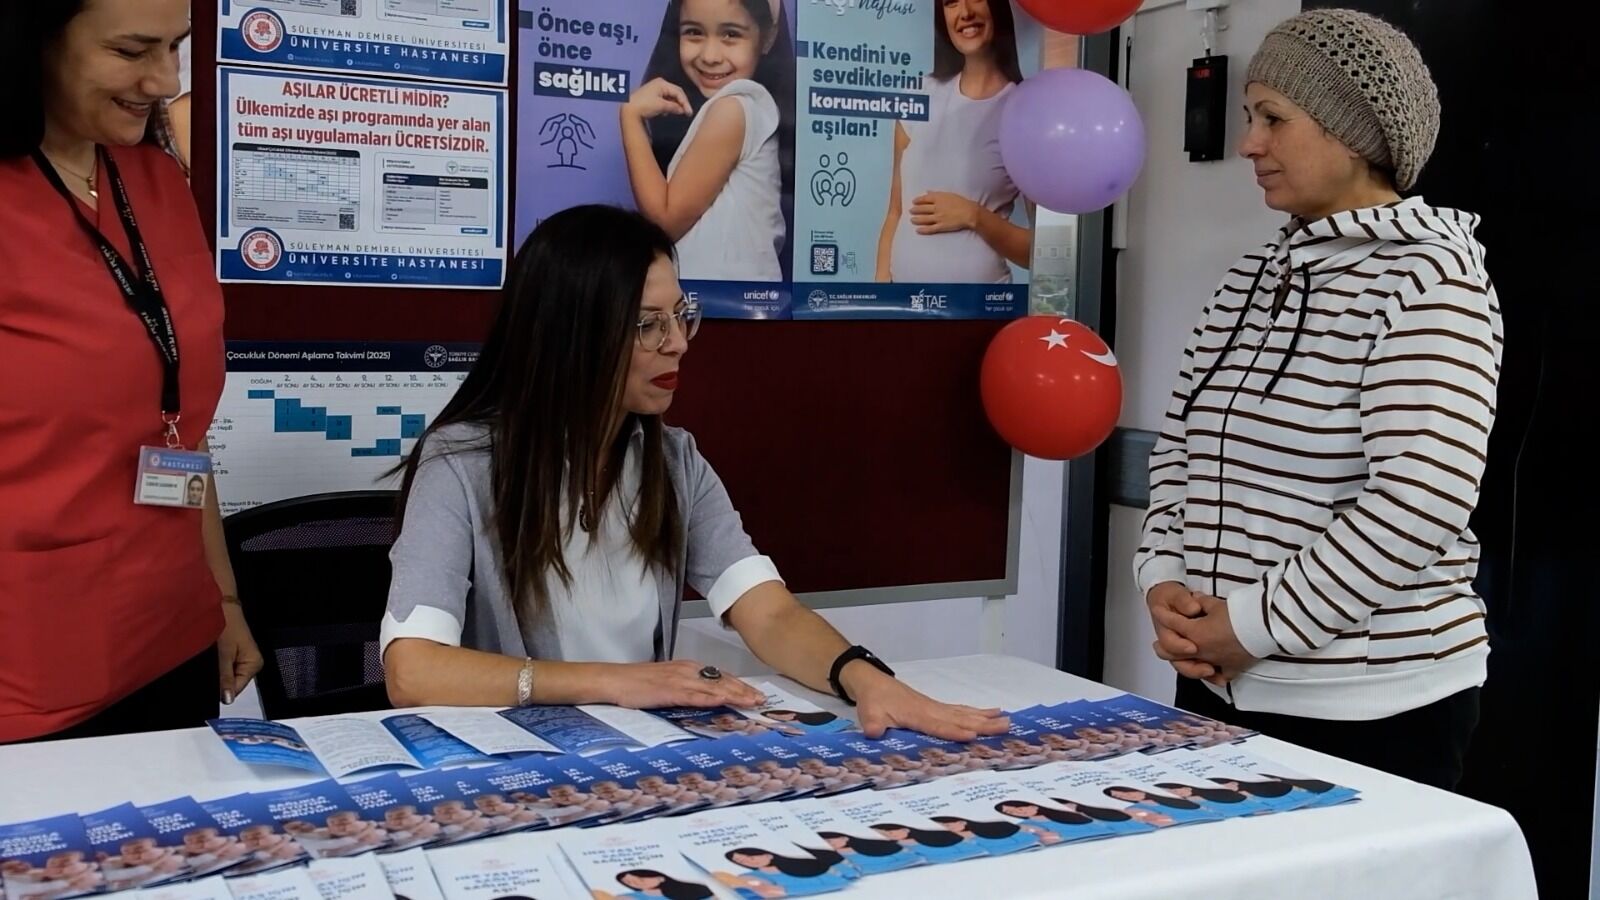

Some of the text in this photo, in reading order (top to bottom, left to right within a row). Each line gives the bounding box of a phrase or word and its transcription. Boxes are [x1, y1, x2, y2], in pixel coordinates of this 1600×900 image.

[291, 24, 487, 50] SÜLEYMAN DEMİREL ÜNİVERSİTESİ
[538, 7, 639, 45] Önce aşı,
[290, 36, 391, 55] ÜNİVERSİTE
[400, 47, 487, 65] HASTANESİ
[538, 37, 592, 60] önce
[813, 41, 911, 66] Kendini ve
[538, 68, 626, 97] sağlık!
[813, 66, 923, 90] sevdiklerini
[282, 81, 450, 108] AŞILAR ÜCRETLİ MİDİR?
[811, 92, 925, 118] korumak için
[236, 97, 490, 132] Ülkemizde aşı programında yer alan
[238, 122, 489, 153] tüm aşı uygulamaları ÜCRETSİZDİR.
[812, 118, 878, 140] aşılan!
[288, 252, 485, 270] ÜNİVERSİTE HASTANESİ
[290, 242, 485, 256] SÜLEYMAN DEMİREL ÜNİVERSİTESİ
[744, 290, 769, 299] unicef
[924, 295, 947, 308] TAE
[985, 291, 1005, 300] unicef
[226, 351, 391, 361] Çocukluk Dönemi Aşılama Takvimi (2025)
